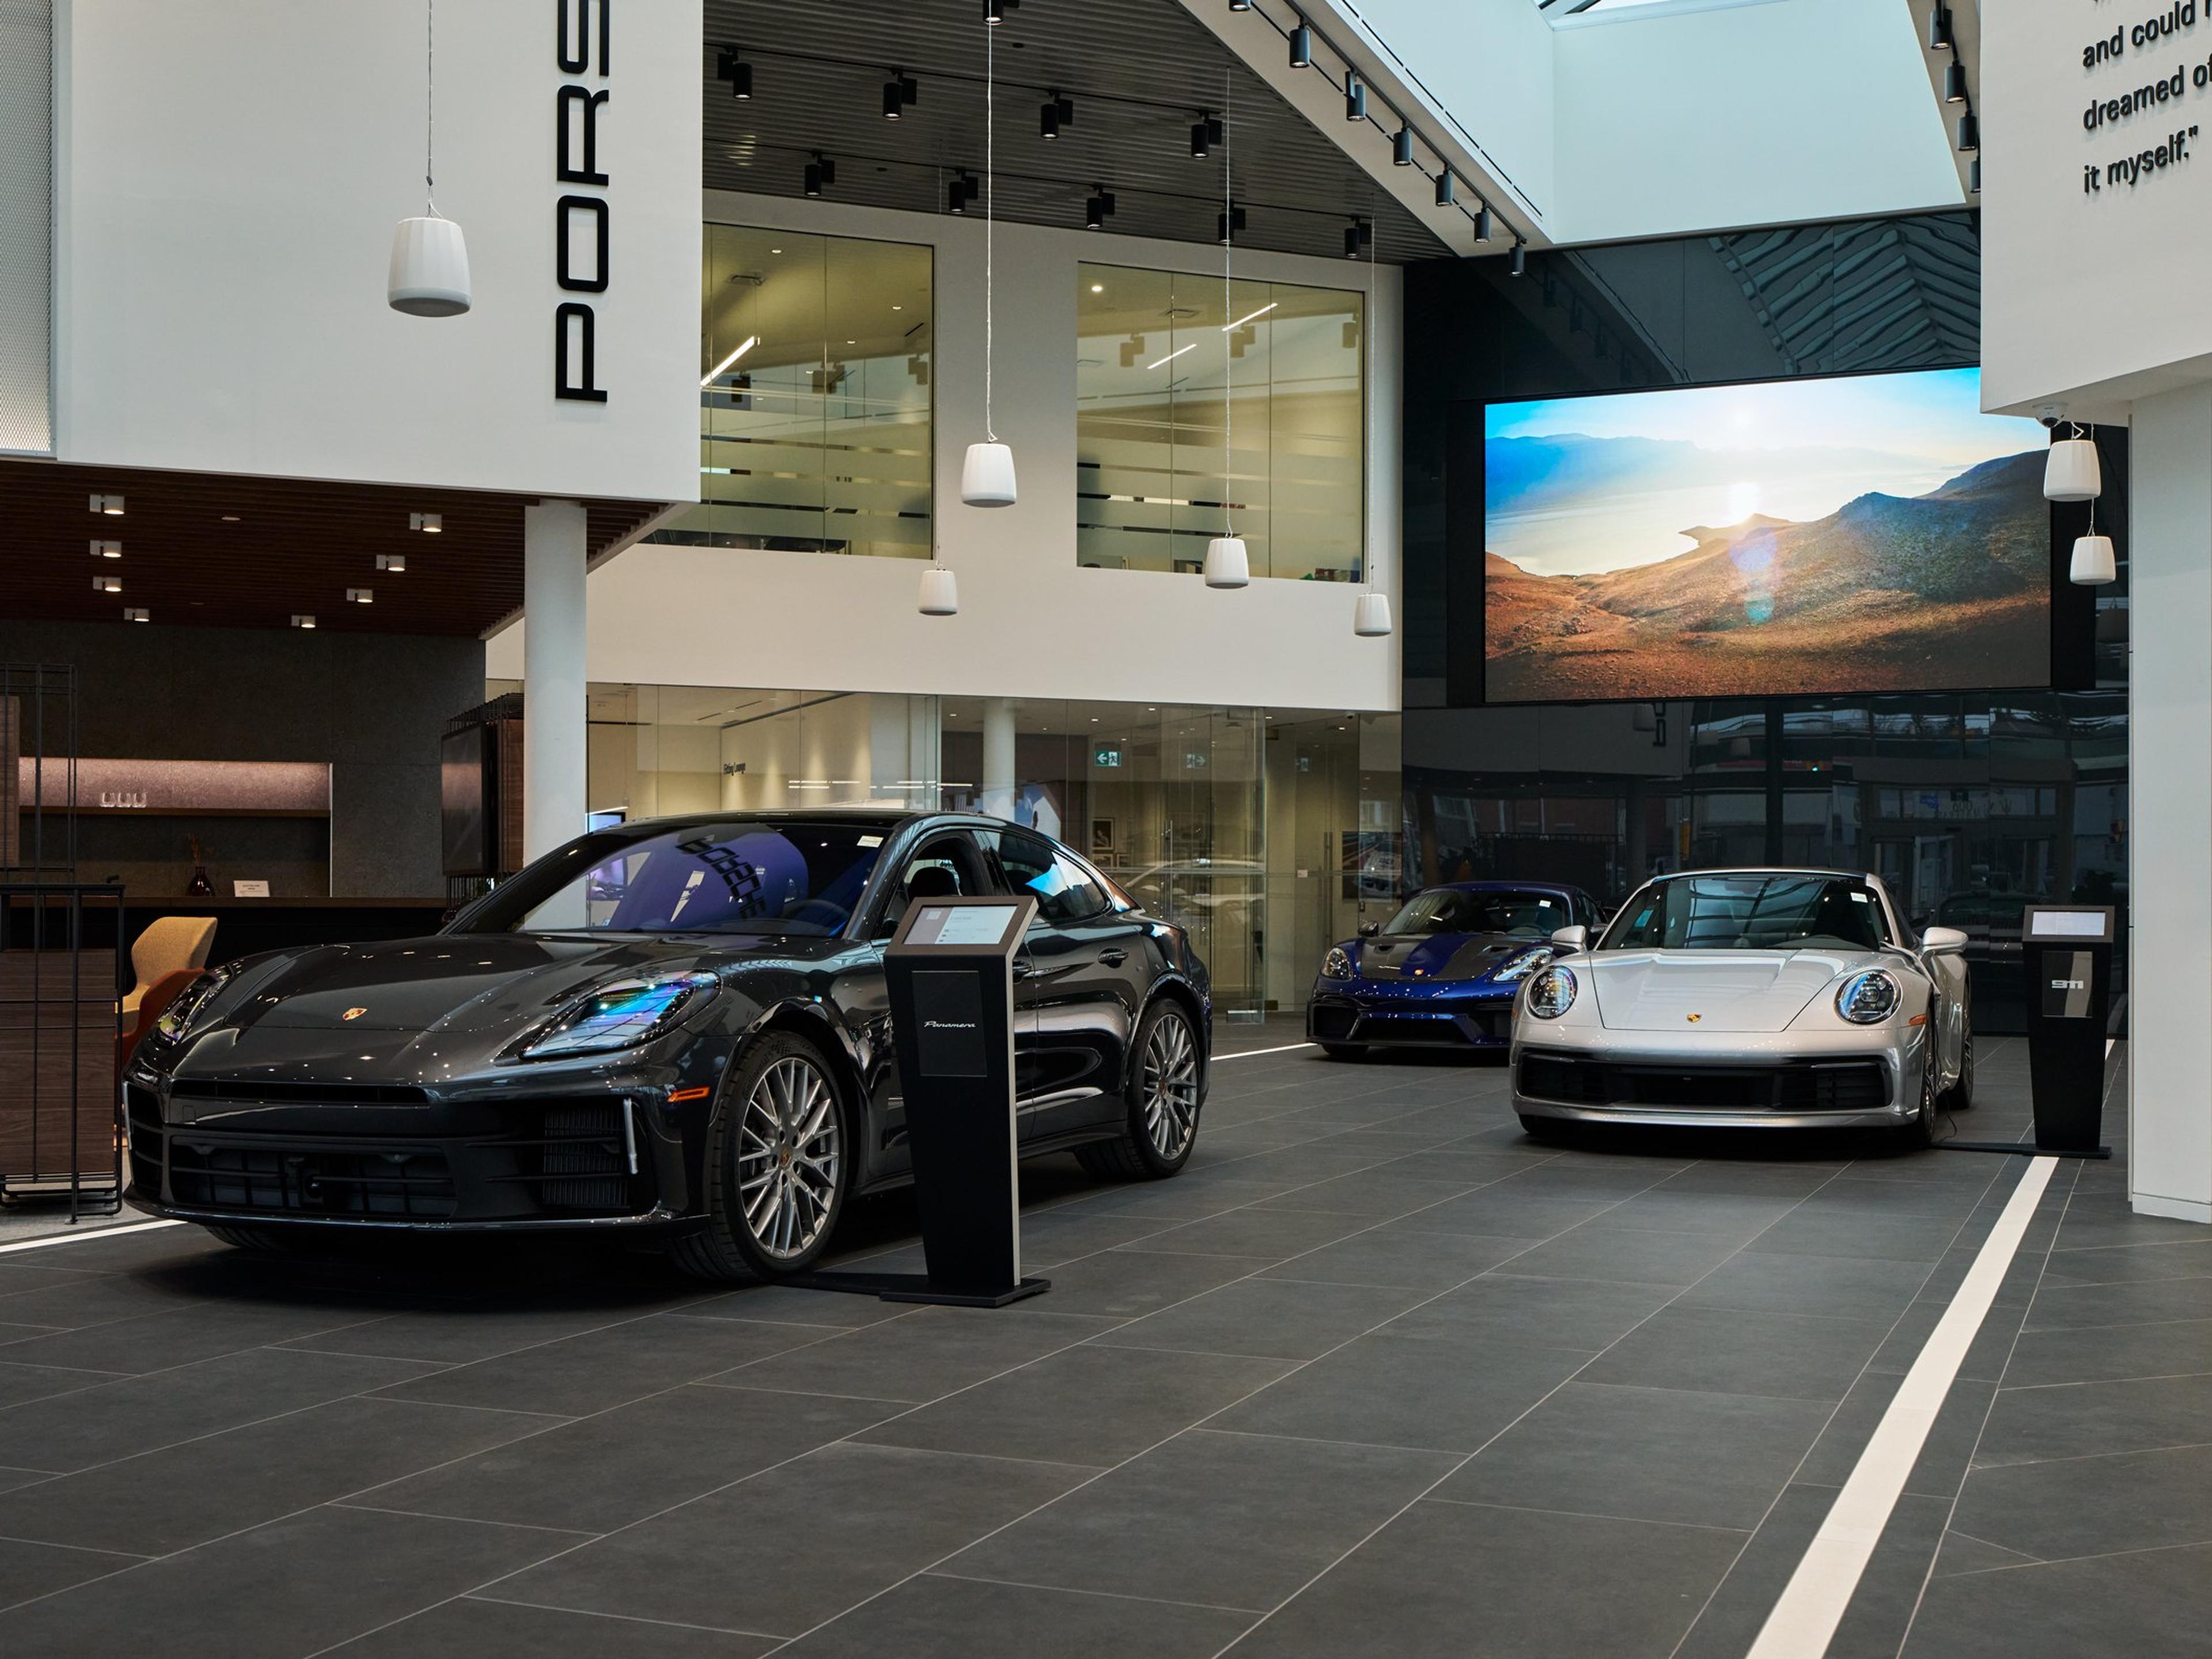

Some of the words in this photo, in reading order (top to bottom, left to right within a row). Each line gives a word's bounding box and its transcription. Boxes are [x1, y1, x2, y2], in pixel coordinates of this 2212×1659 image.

[2082, 25, 2123, 67] and
[2131, 0, 2196, 47] could
[2083, 65, 2184, 130] dreamed
[555, 0, 609, 403] PORS
[2084, 165, 2101, 194] it
[2051, 980, 2084, 989] 911
[923, 1020, 976, 1028] Panamera
